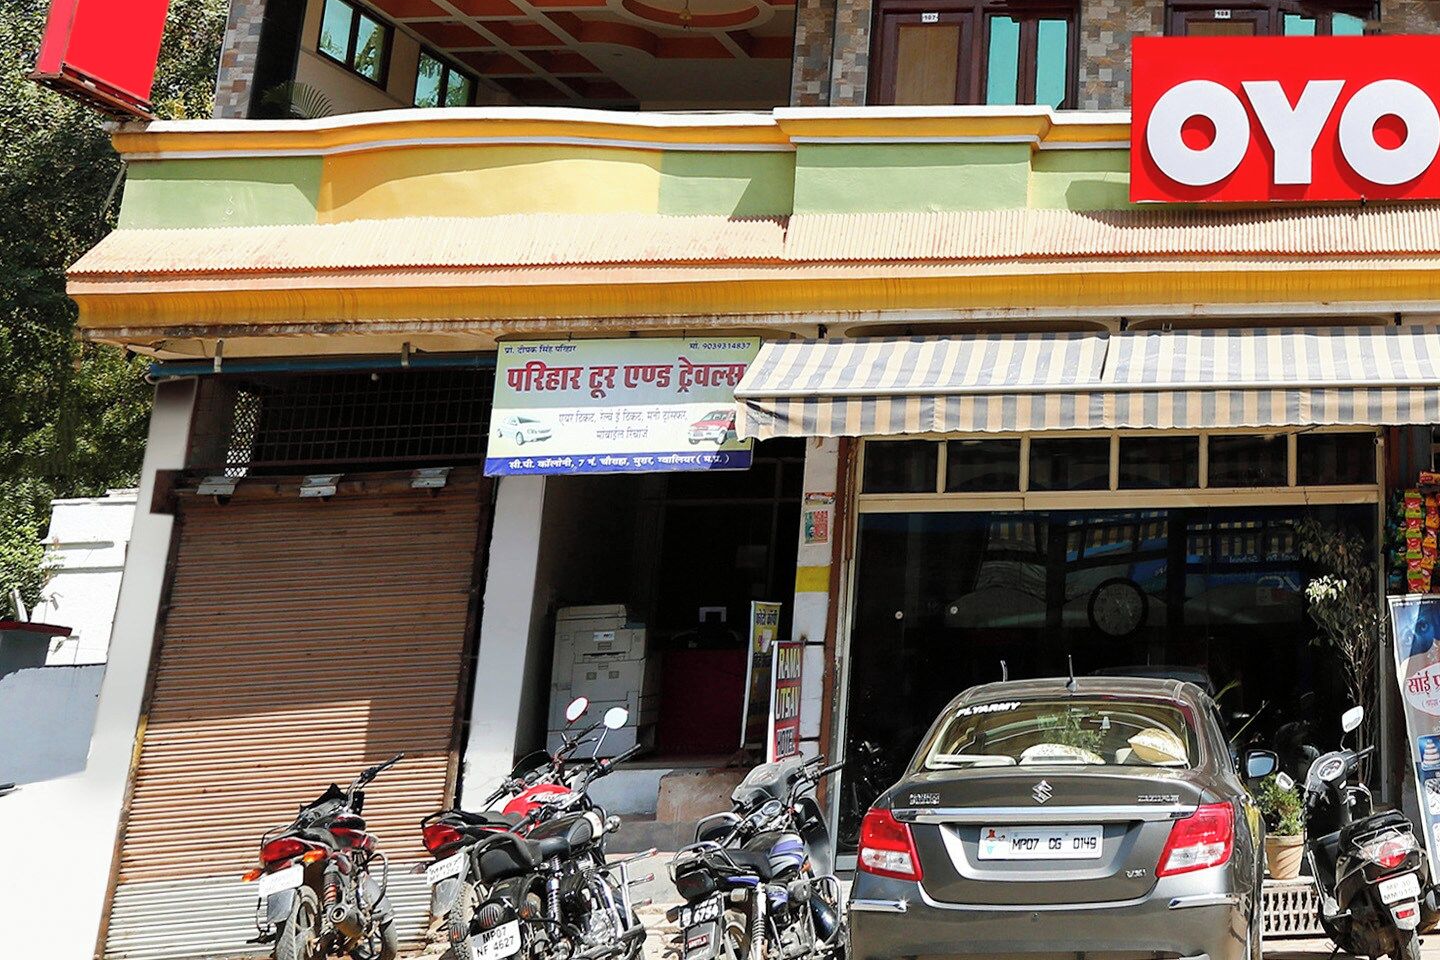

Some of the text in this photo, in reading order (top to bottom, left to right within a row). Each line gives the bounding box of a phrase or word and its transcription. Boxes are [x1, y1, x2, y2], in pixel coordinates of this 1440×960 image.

[702, 342, 751, 350] 9039314837
[507, 356, 748, 399] परिहार टूर एण्ड ट्रेवल्स
[1011, 837, 1040, 851] MP07
[1072, 837, 1097, 850] 0149
[482, 926, 507, 944] MP07
